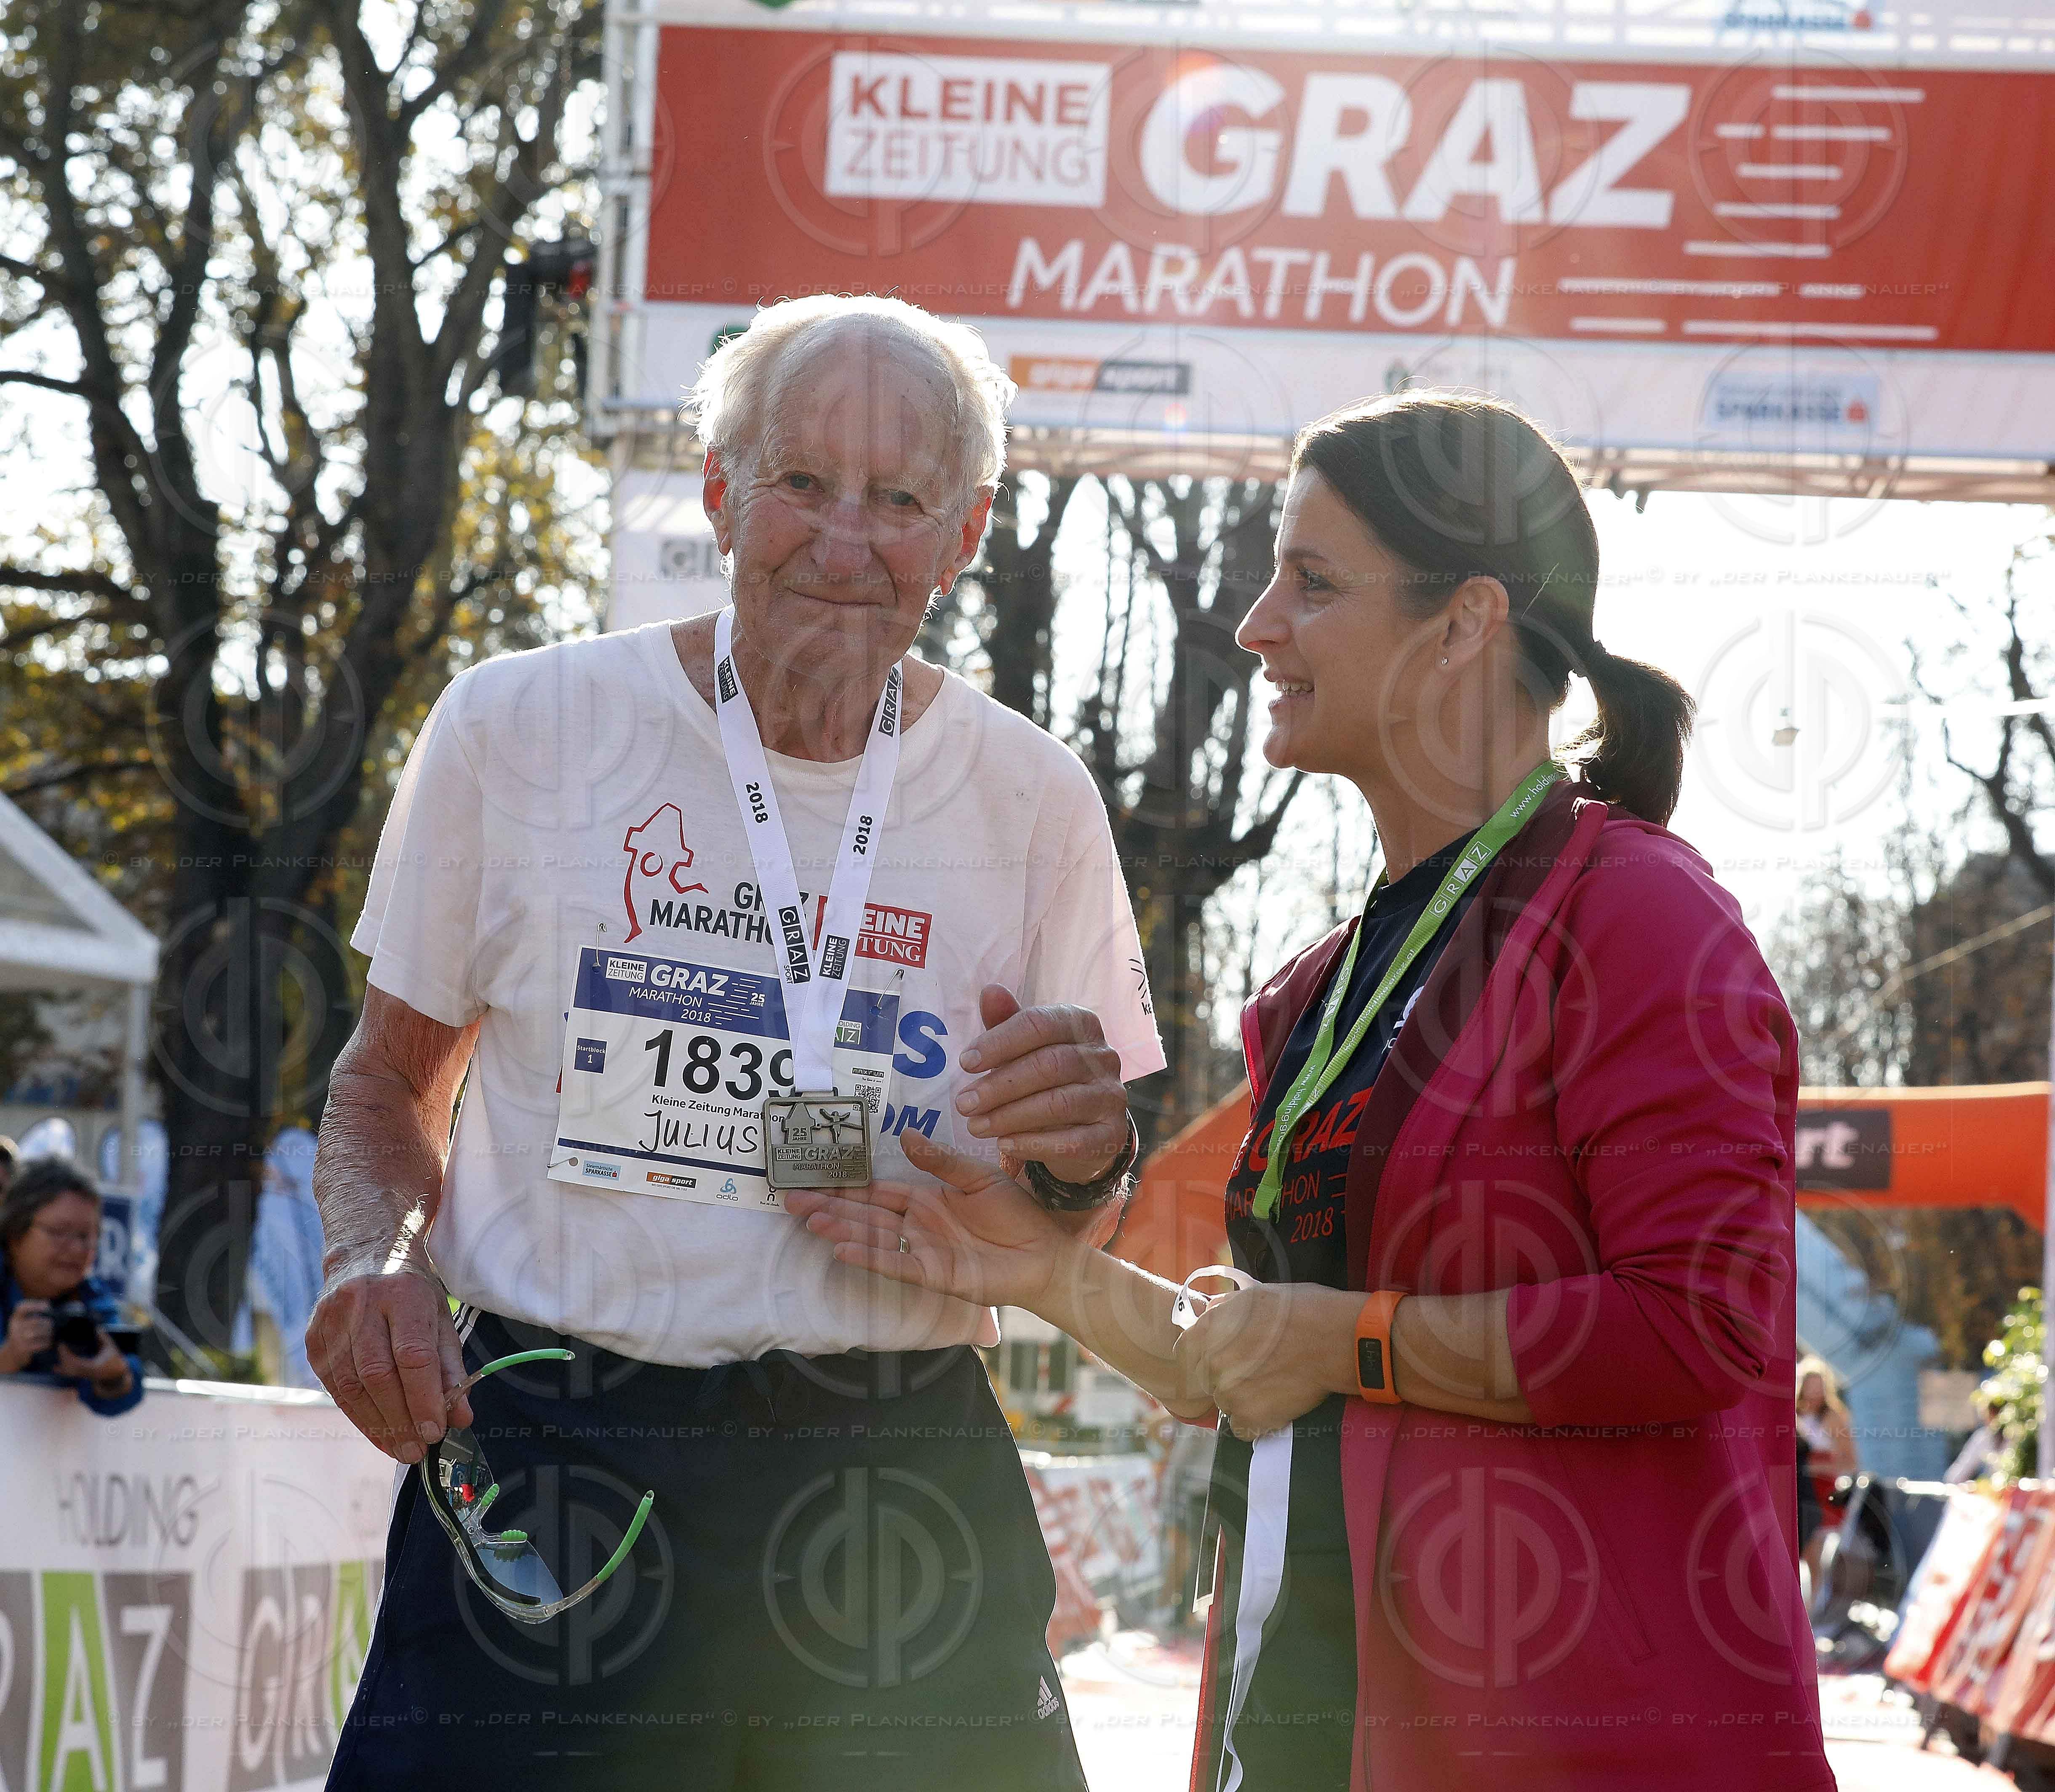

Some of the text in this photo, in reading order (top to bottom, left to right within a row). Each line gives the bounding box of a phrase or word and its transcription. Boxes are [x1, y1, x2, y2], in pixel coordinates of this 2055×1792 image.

[843, 126, 1092, 187] ZEITUNG
[849, 62, 1692, 230] KLEINE GRAZ
[1006, 237, 1517, 329] MARATHON
[718, 664, 730, 700] ZEITUNG
[723, 659, 736, 696] KLEINE
[882, 669, 898, 733] GRAZ
[745, 781, 769, 824] 2018
[853, 815, 873, 855] 2018
[1433, 843, 1489, 916] GRAZ
[862, 908, 925, 940] EINE
[782, 909, 809, 980] GRAZ
[822, 937, 838, 976] KLEINE
[857, 936, 921, 962] TUNG
[831, 939, 847, 977] ZEITUNG
[608, 968, 643, 981] ZEITUNG
[609, 960, 730, 997] KLEINE GRAZ
[784, 965, 793, 984] SPORT
[628, 986, 703, 1008] MARATHON
[750, 992, 766, 1003] 25
[680, 1008, 712, 1023] 2018
[838, 1020, 861, 1029] OLDING
[576, 1044, 606, 1054] Startblock
[587, 1054, 593, 1064] 1
[652, 1094, 686, 1109] Kleine
[688, 1099, 731, 1117] Zeitung
[638, 1109, 759, 1156] JULIUS
[793, 1128, 807, 1137] 25
[804, 1146, 855, 1161] GRAZ
[585, 1168, 612, 1177] SPARKASSE
[793, 1163, 840, 1171] MARATHON
[671, 1177, 693, 1185] sport
[716, 1193, 739, 1202] odlo
[1290, 1206, 1334, 1243] 2018
[1038, 1696, 1060, 1720] adidas
